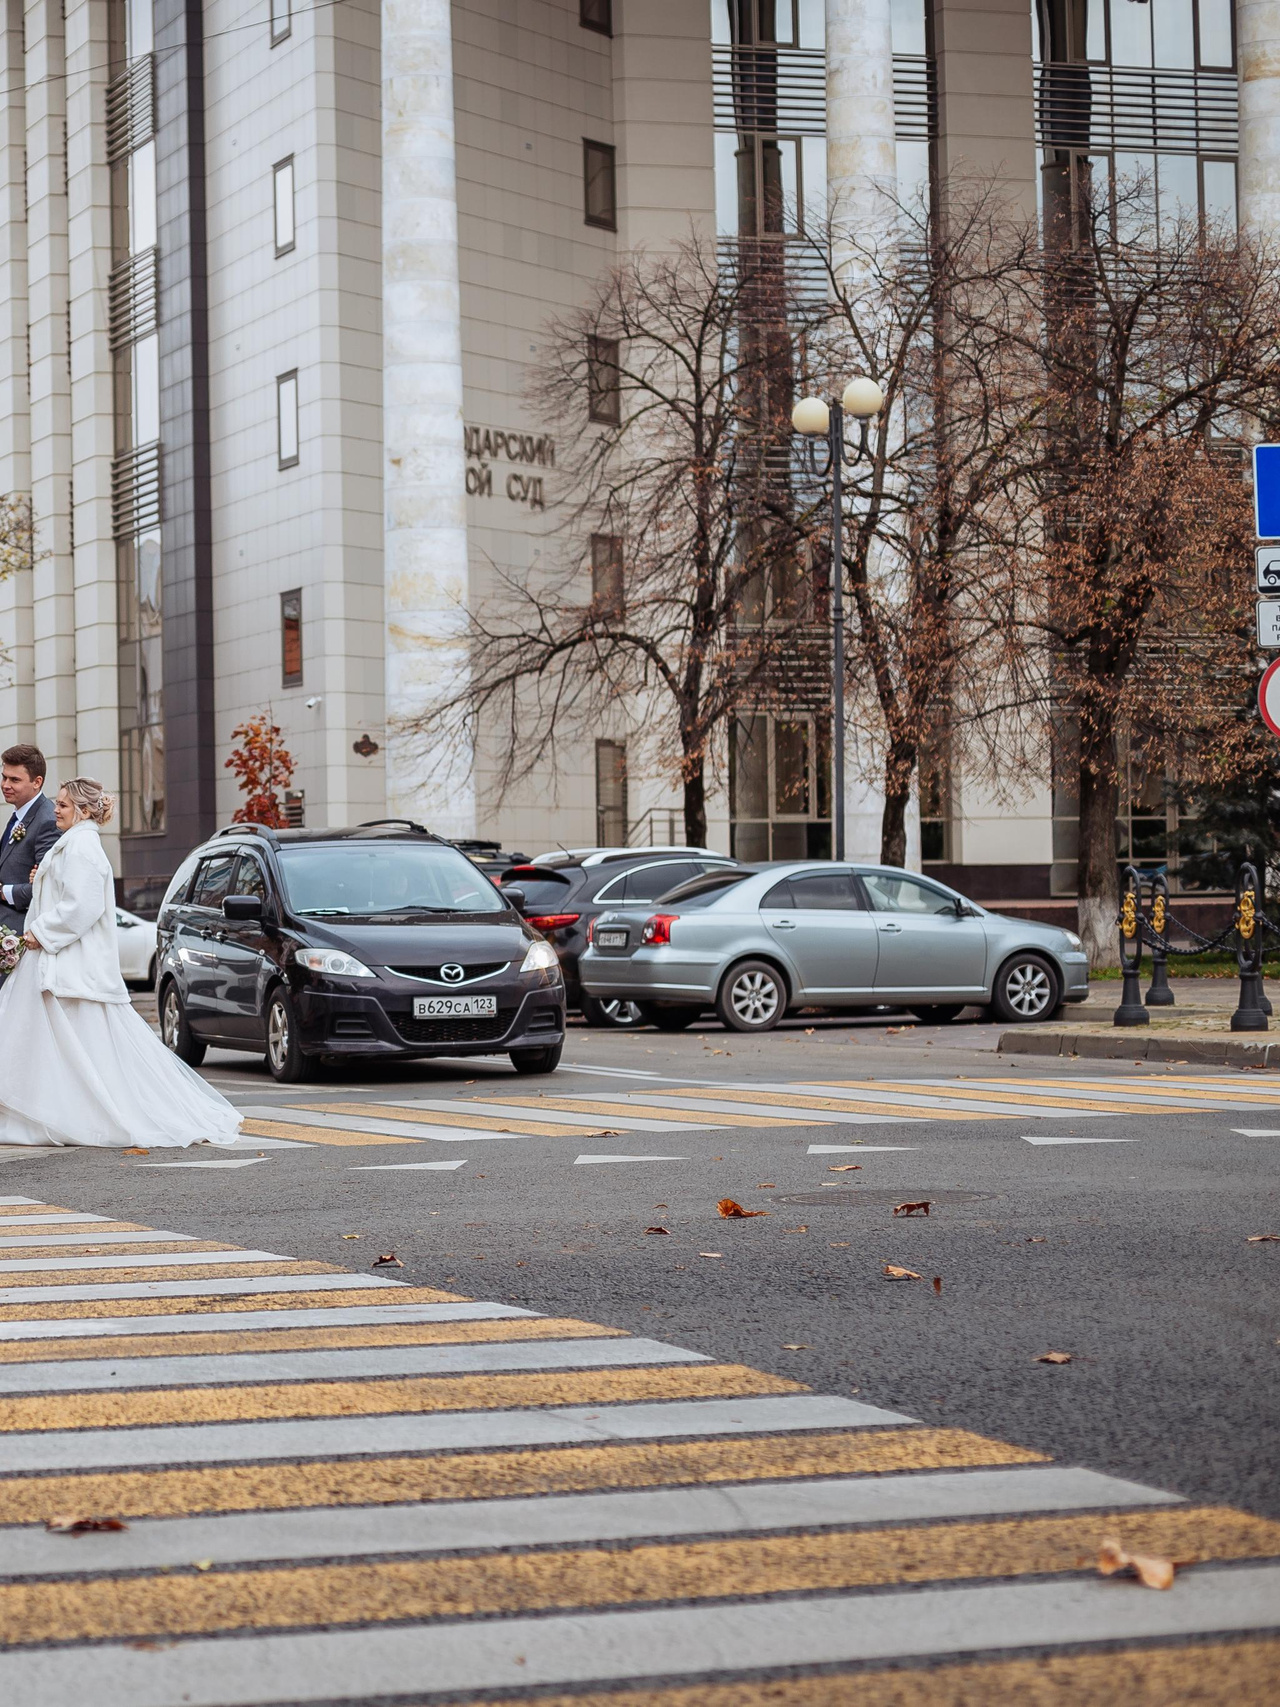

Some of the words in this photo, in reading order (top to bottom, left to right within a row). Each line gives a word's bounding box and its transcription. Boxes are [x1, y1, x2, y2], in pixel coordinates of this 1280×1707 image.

[506, 473, 545, 511] СУД
[418, 1000, 471, 1014] В629СА
[473, 998, 493, 1009] 123
